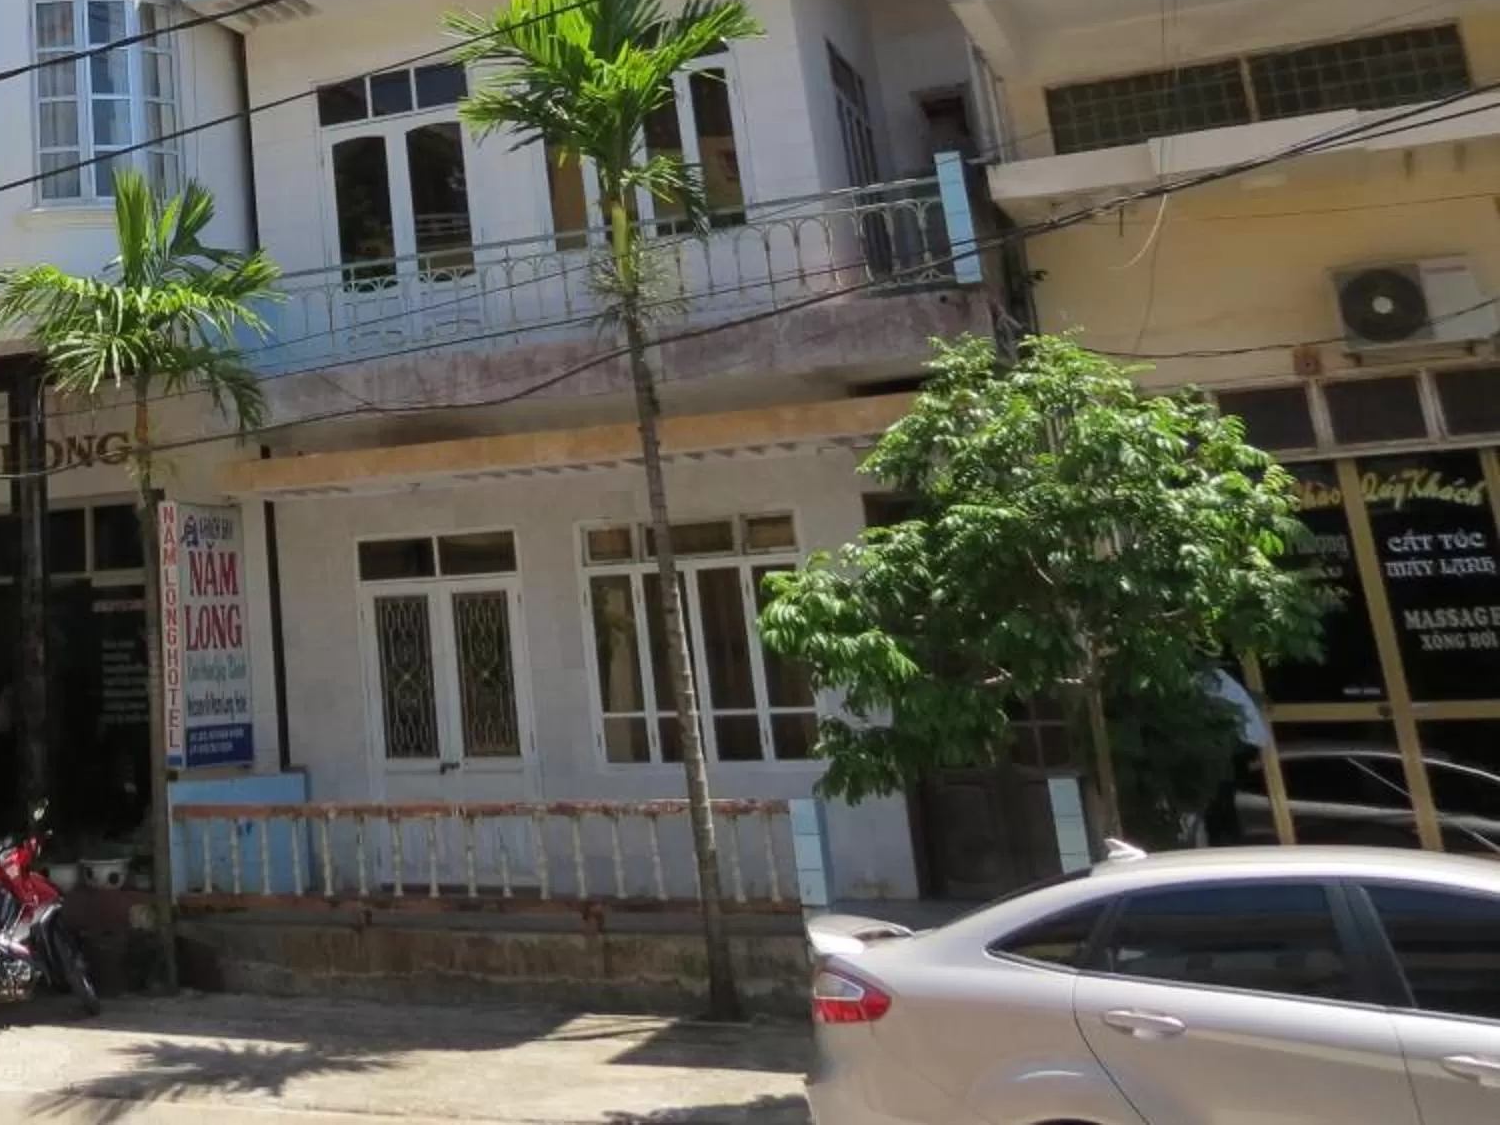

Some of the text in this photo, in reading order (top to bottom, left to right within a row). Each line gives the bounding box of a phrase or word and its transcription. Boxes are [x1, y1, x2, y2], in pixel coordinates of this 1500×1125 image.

[188, 540, 239, 597] NĂM
[184, 603, 243, 652] LONG
[1403, 606, 1500, 630] MASSAGE
[167, 648, 181, 748] HOTEL
